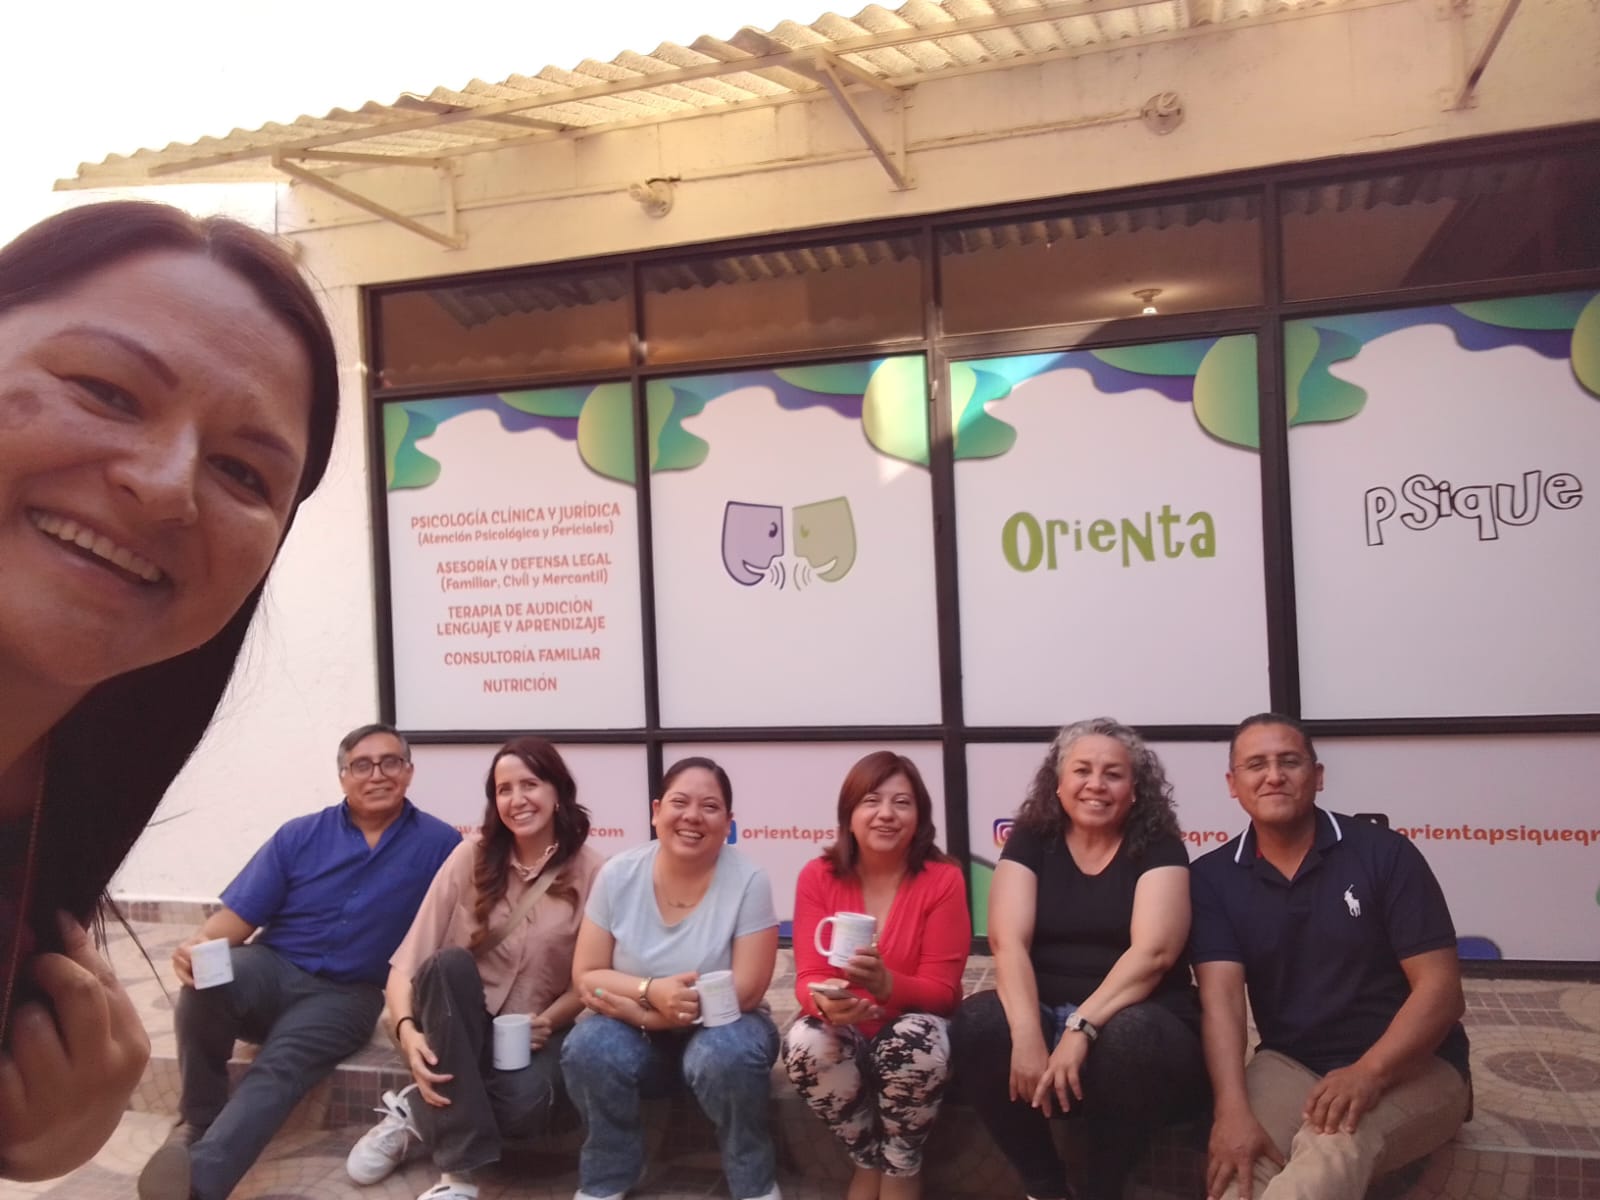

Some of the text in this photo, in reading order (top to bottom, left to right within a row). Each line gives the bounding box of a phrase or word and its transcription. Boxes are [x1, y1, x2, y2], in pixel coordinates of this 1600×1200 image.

[411, 500, 621, 529] PSICOLOGÍA CLÍNICA Y JURÍDICA
[418, 519, 614, 546] (Atención Psicológica y Periciales)
[436, 553, 612, 574] ASESORÍA Y DEFENSA LEGAL
[532, 575, 540, 588] y
[542, 568, 608, 585] Mercantil)
[448, 596, 593, 619] TERAPIA DE AUDICIÓN
[436, 616, 606, 638] LENGUAJE Y APRENDIZAJE
[444, 645, 601, 666] CONSULTORÍA FAMILIAR
[483, 673, 557, 693] NUTRICIÓN
[742, 826, 838, 843] orientaps
